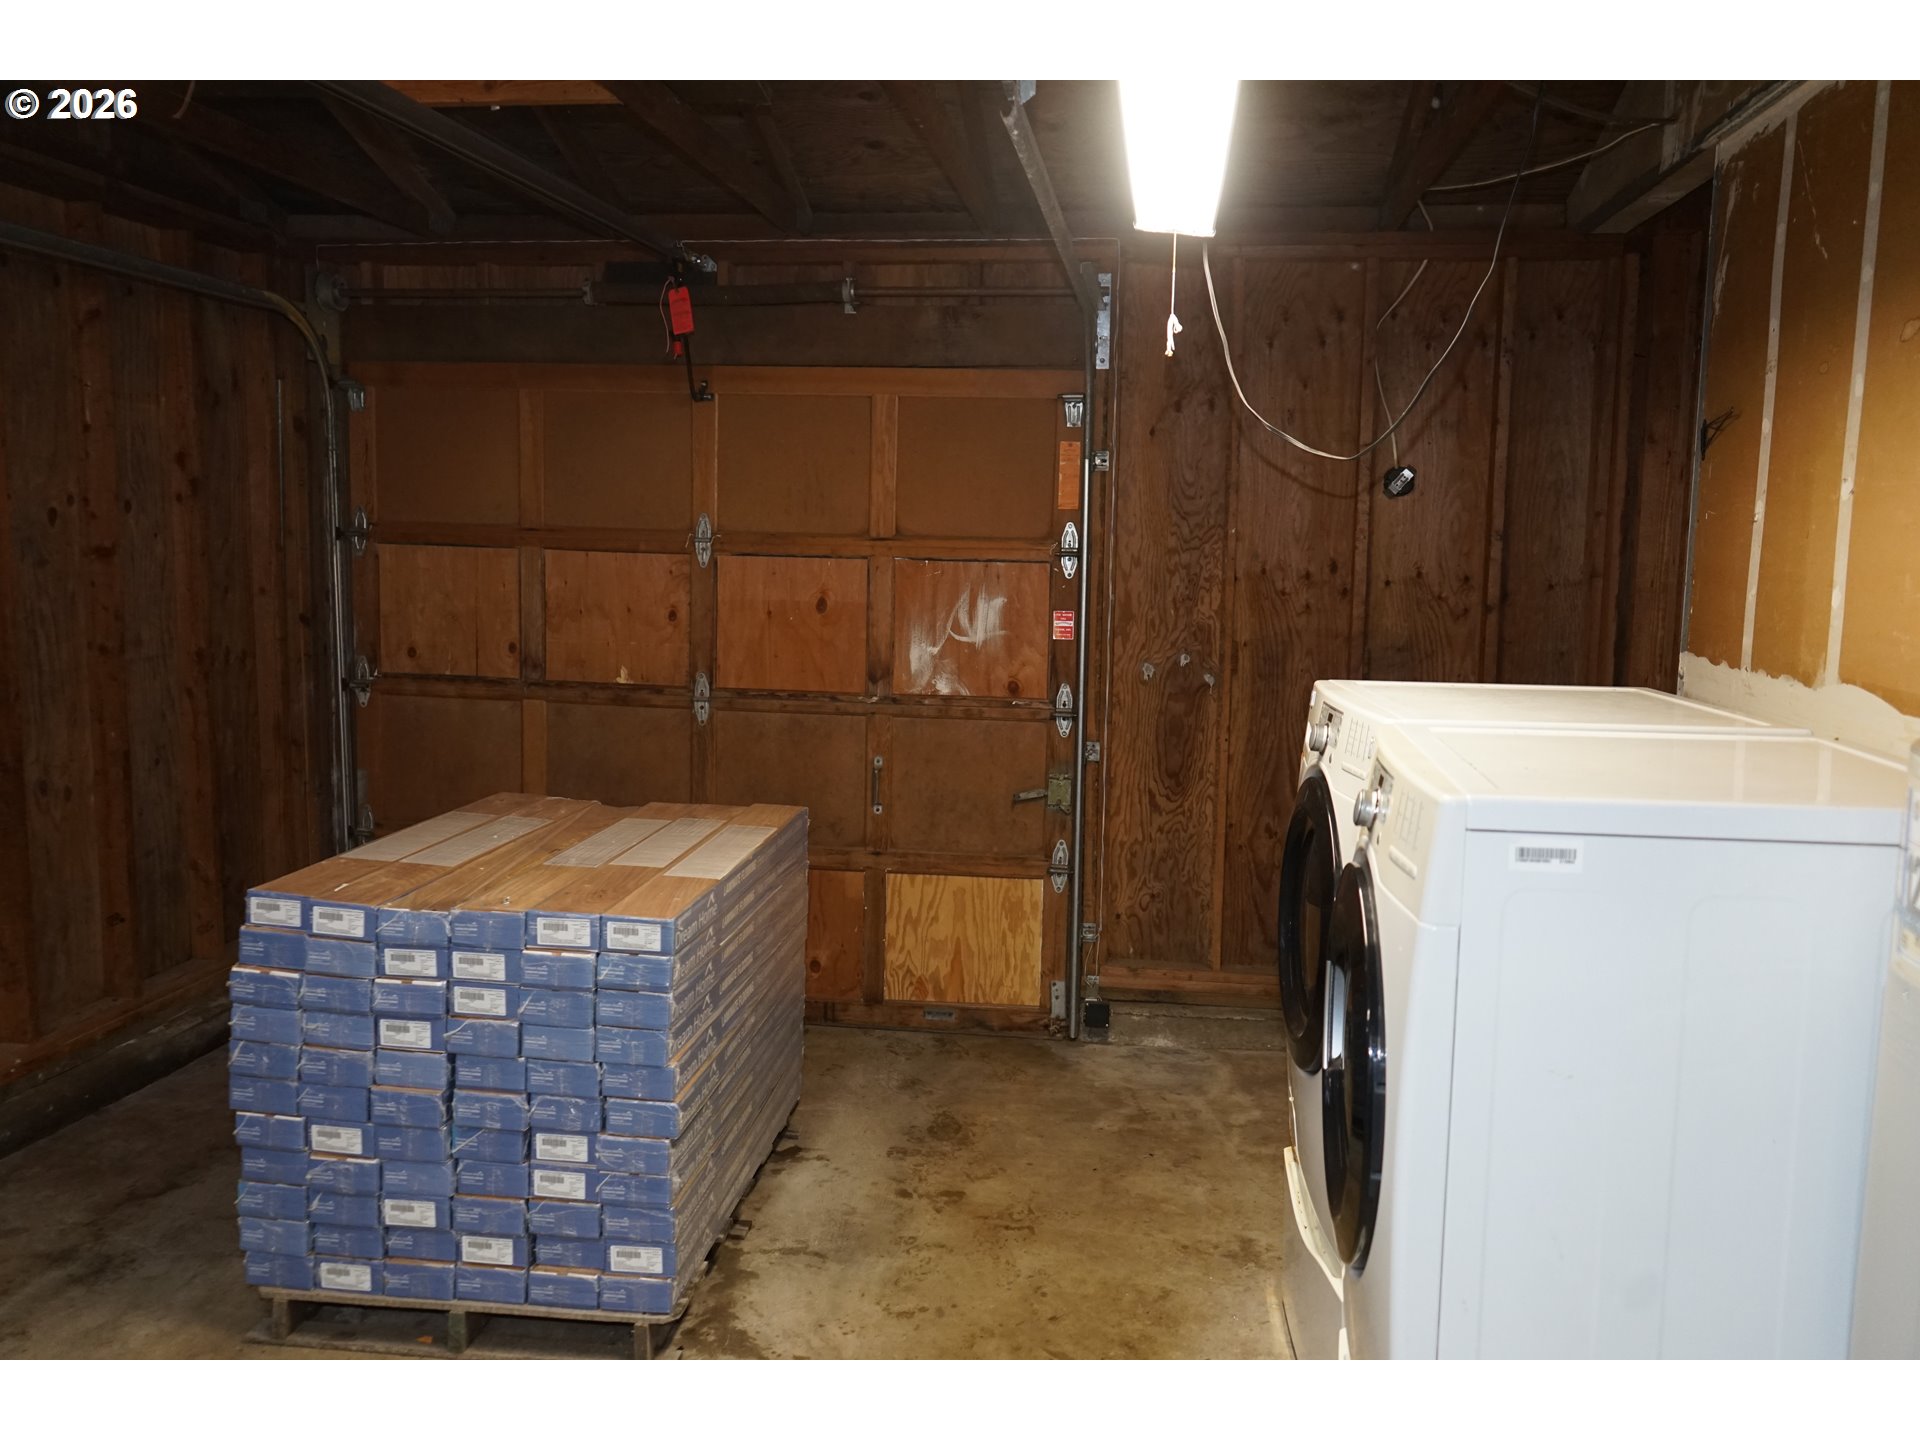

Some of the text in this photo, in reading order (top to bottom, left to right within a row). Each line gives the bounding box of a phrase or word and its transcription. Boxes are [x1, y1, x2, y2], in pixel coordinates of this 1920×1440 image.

[675, 920, 698, 950] Dream
[698, 903, 718, 930] Home
[697, 936, 716, 965] Home
